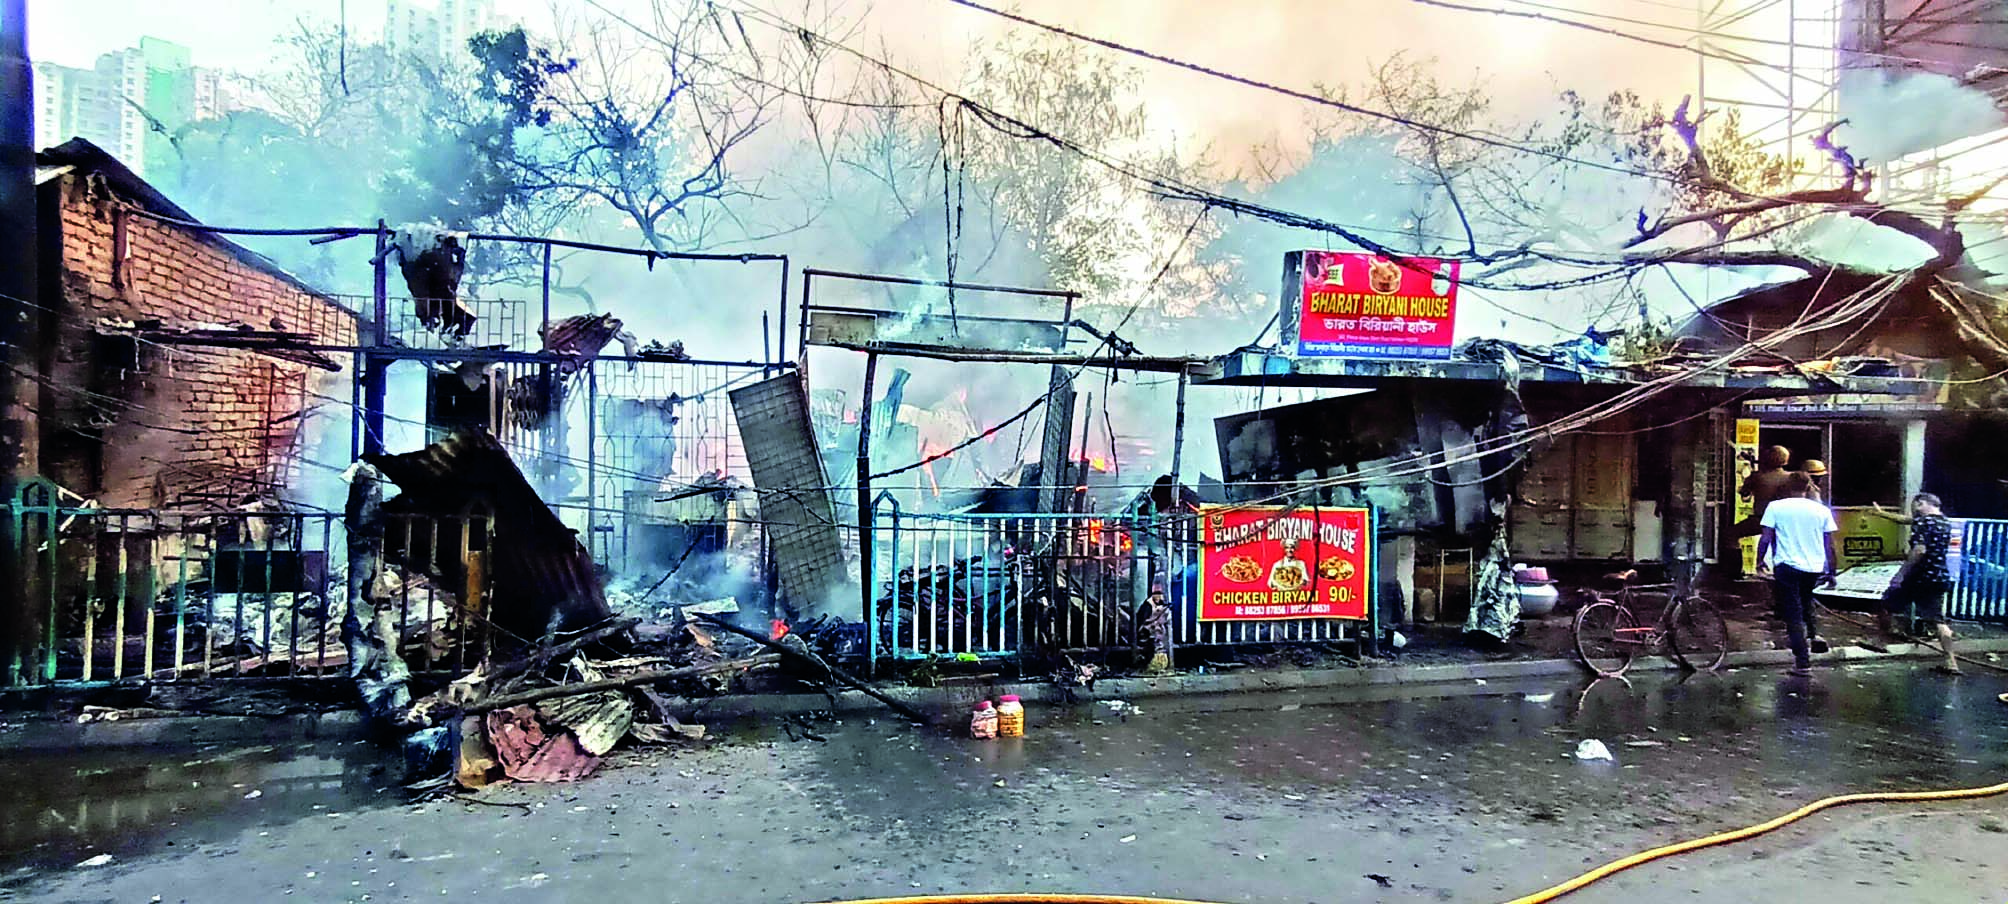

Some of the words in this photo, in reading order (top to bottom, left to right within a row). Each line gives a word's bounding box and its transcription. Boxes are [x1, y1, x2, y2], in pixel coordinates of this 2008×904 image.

[1310, 292, 1360, 313] BHARAT
[1363, 294, 1408, 316] BIRYANI
[1410, 297, 1449, 318] HOUSE
[1323, 317, 1357, 331] ভারত
[1214, 520, 1264, 552] BHARAT
[1267, 517, 1313, 541] BIRYANI
[1213, 591, 1268, 604] CHICKEN
[1329, 586, 1357, 603] 90/-
